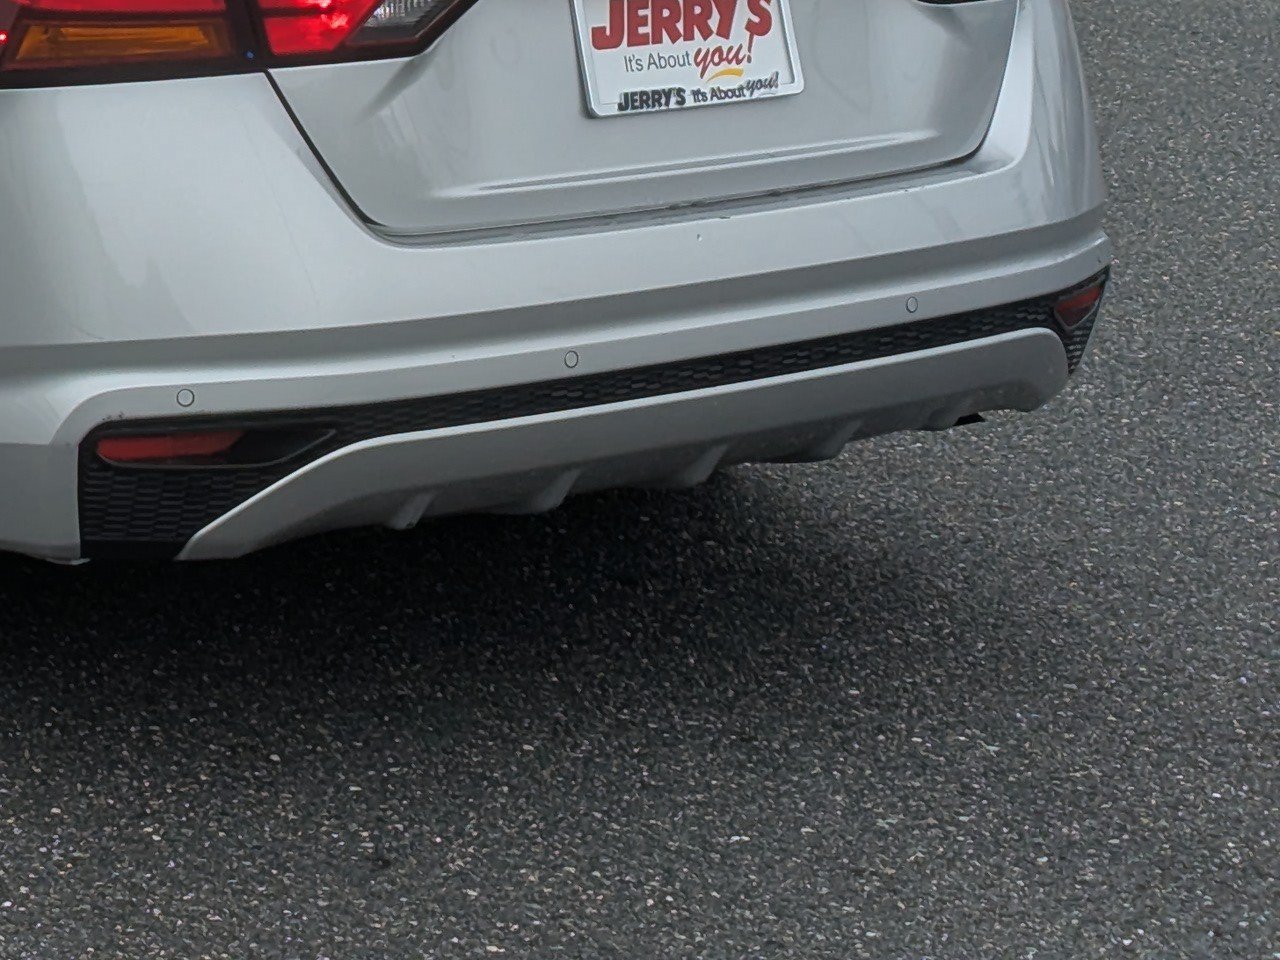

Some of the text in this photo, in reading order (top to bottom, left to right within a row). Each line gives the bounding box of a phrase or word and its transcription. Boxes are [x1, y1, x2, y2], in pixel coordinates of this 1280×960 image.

[624, 31, 754, 80] It's About you!
[617, 86, 687, 112] JERRY'S
[709, 86, 746, 102] About
[745, 70, 780, 96] you!
